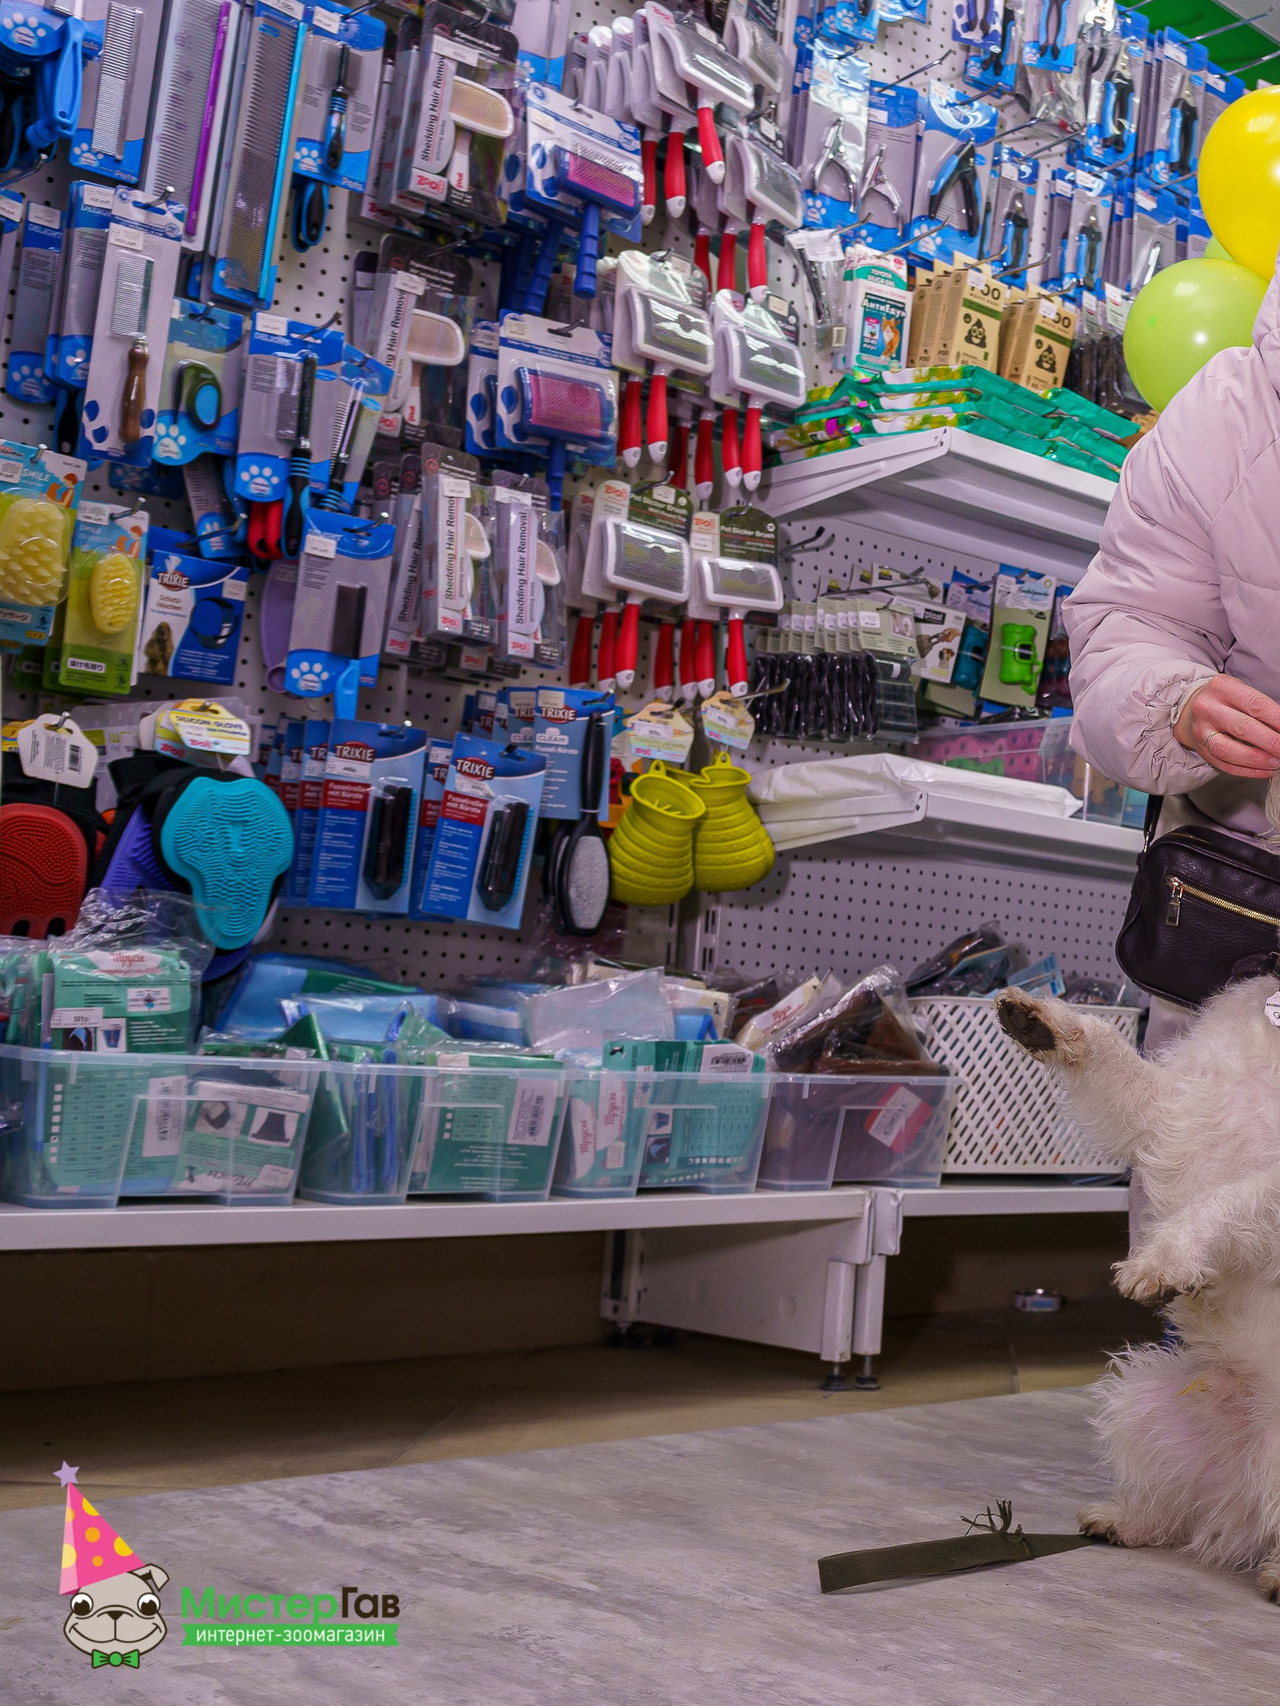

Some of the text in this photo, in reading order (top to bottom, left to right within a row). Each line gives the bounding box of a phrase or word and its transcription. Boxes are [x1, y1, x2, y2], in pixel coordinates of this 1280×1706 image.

[421, 115, 437, 162] Shedding
[430, 90, 442, 114] Hair
[446, 531, 456, 557] Hair
[445, 558, 457, 601] Shedding
[515, 512, 528, 625] Shedding Hair Removal
[157, 572, 190, 589] TRIXIE
[541, 707, 577, 721] TRIXIE
[335, 745, 375, 761] TRIXIE
[455, 758, 496, 779] TRIXIE
